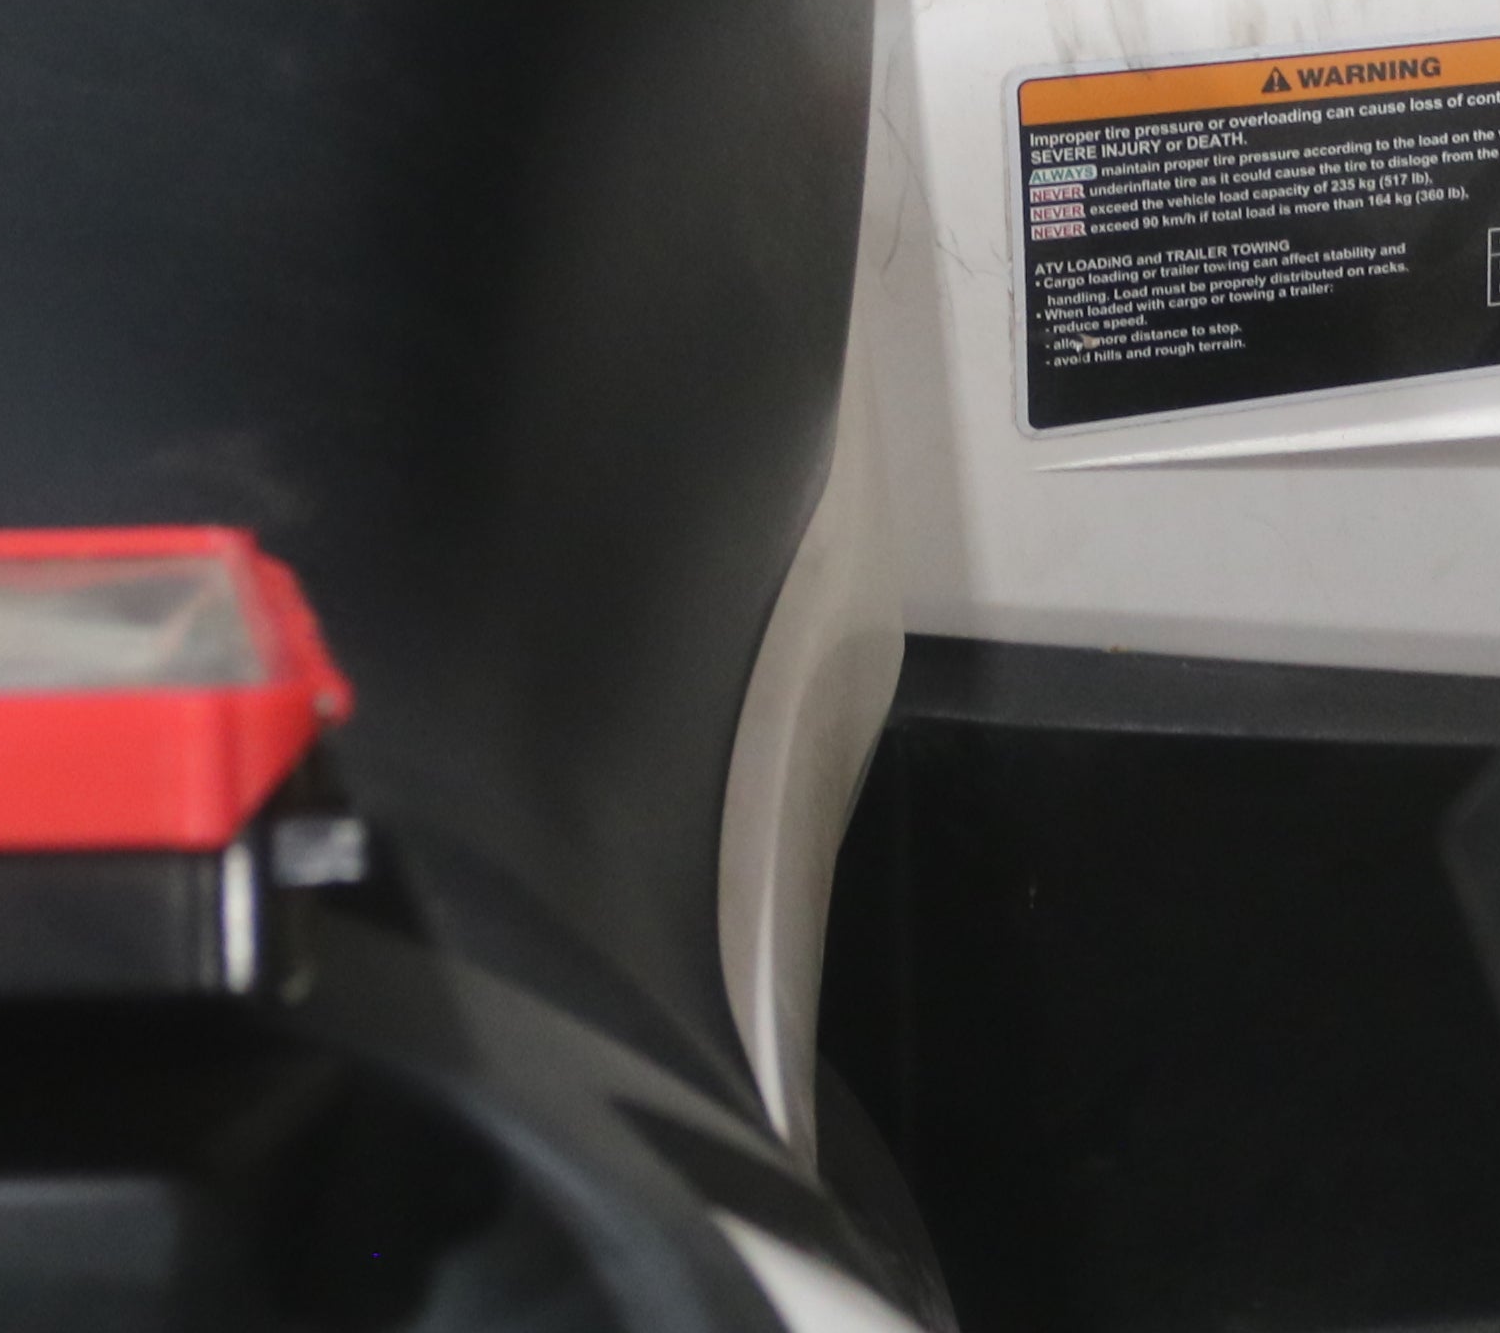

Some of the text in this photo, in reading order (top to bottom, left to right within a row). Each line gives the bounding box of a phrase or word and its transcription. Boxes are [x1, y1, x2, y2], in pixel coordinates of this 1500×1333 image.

[1297, 57, 1441, 88] WARNING
[1029, 130, 1101, 148] Improper
[1104, 125, 1130, 140] tire
[1134, 120, 1204, 140] pressure
[1207, 118, 1225, 130] or
[1228, 108, 1322, 128] overloading
[1325, 106, 1355, 119] can
[1358, 101, 1406, 116] cause
[1409, 97, 1443, 111] loss
[1446, 92, 1463, 108] of
[1030, 133, 1247, 164] SEVERE INJURY or DEATH.
[1031, 166, 1096, 184] ALWAYS
[1100, 161, 1160, 176] maintain
[1163, 157, 1209, 173] proper
[1212, 153, 1236, 166] tire
[1238, 149, 1300, 166] pressure
[1302, 141, 1372, 157] according
[1375, 139, 1390, 151] to
[1392, 136, 1415, 150] the
[1418, 132, 1448, 147] load
[1451, 132, 1470, 144] on
[1472, 128, 1495, 142] the
[1032, 186, 1084, 203] NEVER
[1088, 178, 1171, 196] underinflate
[1173, 175, 1197, 189] tire
[1199, 175, 1217, 186] as
[1219, 172, 1229, 184] it
[1232, 167, 1271, 183] could
[1274, 165, 1316, 179] cause
[1318, 162, 1341, 175] the
[1343, 159, 1367, 172] tire
[1369, 158, 1385, 170] to
[1387, 154, 1438, 168] disloge
[1441, 150, 1474, 163] from
[1476, 147, 1499, 160] the
[1032, 204, 1084, 221] NEVER
[1089, 199, 1139, 215] exceed
[1141, 197, 1164, 210] the
[1166, 192, 1216, 207] vehicle
[1218, 188, 1249, 203] load
[1252, 183, 1310, 200] capacity
[1312, 180, 1328, 194] of
[1330, 177, 1355, 192] 235
[1358, 177, 1376, 191] kg
[1378, 172, 1408, 190] (517
[1033, 223, 1084, 240] NEVER
[1089, 217, 1139, 234] exceed
[1142, 215, 1159, 229] 90
[1161, 212, 1196, 226] km/h
[1199, 210, 1209, 223] if
[1211, 207, 1242, 222] total
[1245, 204, 1276, 219] load
[1278, 203, 1291, 215] is
[1294, 201, 1330, 214] more
[1332, 197, 1364, 210] than
[1368, 192, 1392, 206] 164
[1394, 192, 1412, 206] kg
[1414, 188, 1444, 204] (360
[1034, 261, 1064, 275] ATV
[1136, 251, 1162, 266] and
[1165, 245, 1227, 262] TRAILER
[1231, 239, 1290, 256] TOWING
[1043, 242, 1406, 289] Cargo loading or trailer towing can affect stability and
[1043, 282, 1333, 320] When loaded with cargo or towing a trailer:
[1052, 313, 1147, 333] reduce speed.
[1053, 338, 1245, 367] avoid hills and rough terrain.
